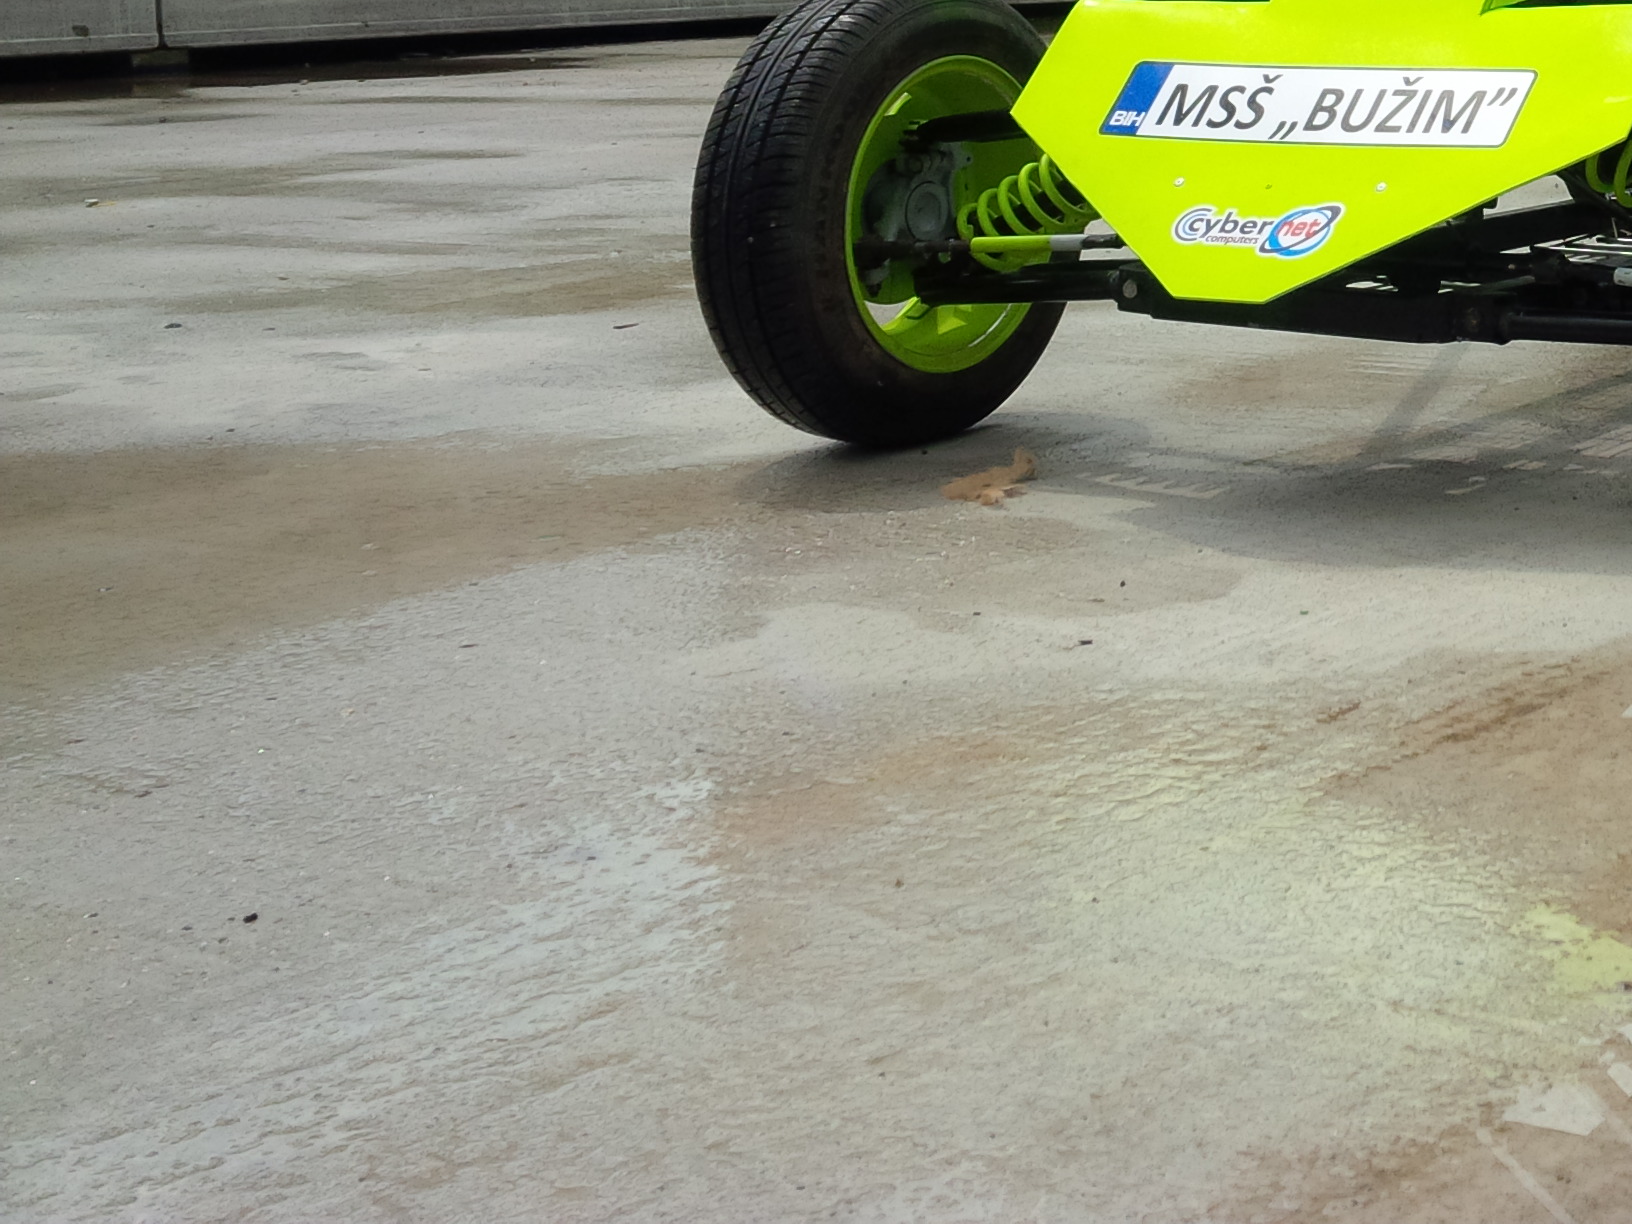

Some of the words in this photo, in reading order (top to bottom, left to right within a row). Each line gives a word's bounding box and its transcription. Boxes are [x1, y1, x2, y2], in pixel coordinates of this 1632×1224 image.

[1155, 73, 1284, 130] MSŠ
[1109, 110, 1146, 127] BIH
[1205, 235, 1260, 246] computers
